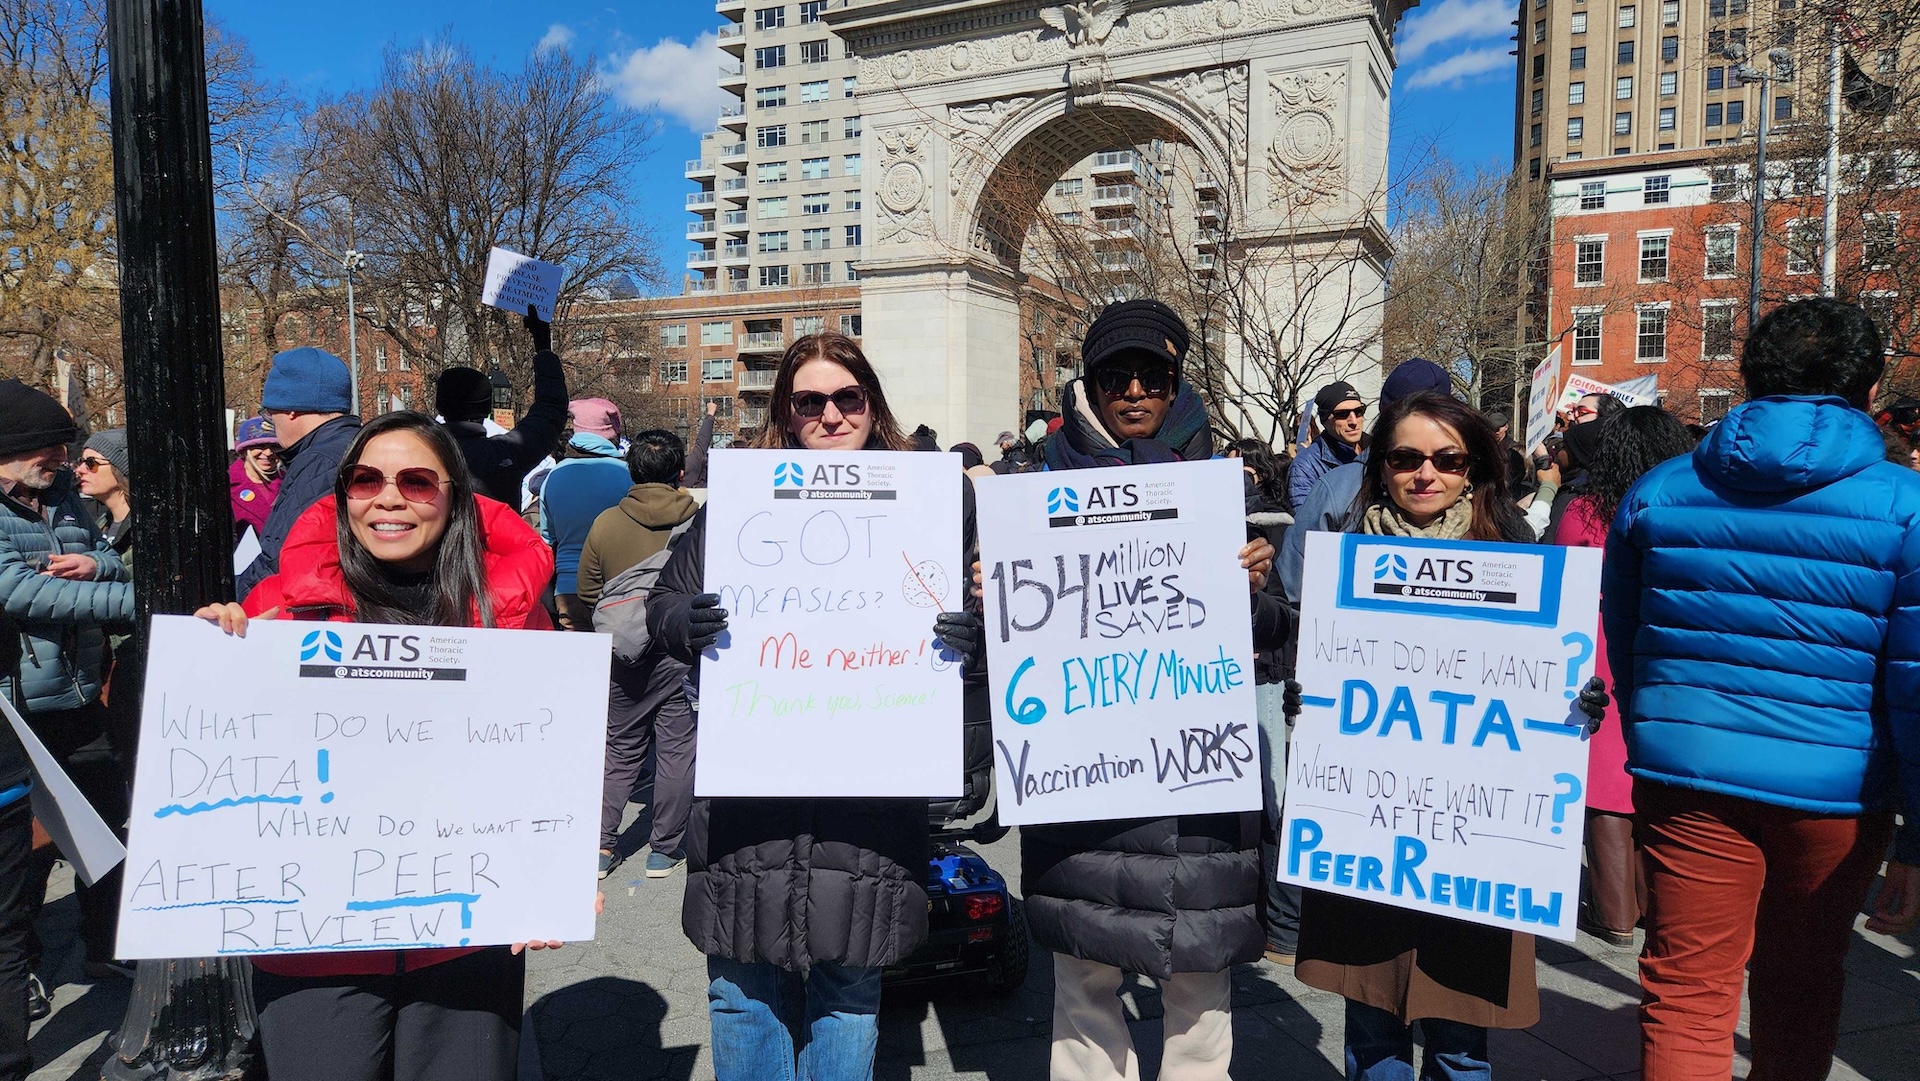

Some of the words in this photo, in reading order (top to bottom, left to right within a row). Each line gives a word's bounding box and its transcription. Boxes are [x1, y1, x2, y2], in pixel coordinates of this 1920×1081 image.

[508, 267, 541, 283] DISEASE
[515, 260, 538, 271] FUND
[488, 290, 505, 300] AND
[496, 273, 549, 295] PREVENTION,
[497, 283, 545, 302] TREATMENT
[811, 464, 860, 485] ATS
[811, 489, 873, 500] atscommunity
[1087, 484, 1139, 509] ATS
[1087, 511, 1152, 524] atscommunity
[737, 509, 887, 567] GOT
[1415, 558, 1474, 584] ATS
[1481, 561, 1517, 569] American
[1481, 570, 1513, 578] Thoracic
[718, 584, 884, 618] MEASLES?
[991, 554, 1091, 643] 154
[1098, 574, 1185, 610] LIVES
[1414, 588, 1487, 601] atscommunity
[1095, 596, 1206, 639] SAVED
[352, 634, 421, 663] ATS
[430, 637, 468, 645] American
[759, 632, 813, 670] Me
[826, 639, 926, 671] neither!
[1314, 618, 1379, 665] WHAT
[1394, 640, 1426, 673] DO
[1435, 648, 1467, 680] WE
[351, 668, 434, 680] atscommunity
[1005, 656, 1047, 725] 6
[1062, 648, 1148, 715] EVERY
[724, 680, 817, 718] Thank
[868, 683, 936, 710] Science!
[161, 692, 273, 740] WHAT
[314, 711, 367, 742] DO
[386, 713, 434, 744] WE
[467, 707, 554, 744] WANT?
[997, 739, 1144, 806] Vaccination
[1150, 721, 1254, 784] WORKS
[1295, 741, 1352, 795] WHEN
[1366, 769, 1397, 798] DO
[1406, 776, 1434, 809] WE
[1446, 780, 1514, 821] WANT
[257, 802, 350, 838] WHEN
[378, 814, 415, 837] DO
[472, 818, 521, 834] WANT
[531, 814, 574, 834] IT?
[1370, 804, 1468, 846] AFTER
[130, 859, 307, 903] AFTER
[350, 848, 500, 898] PEER
